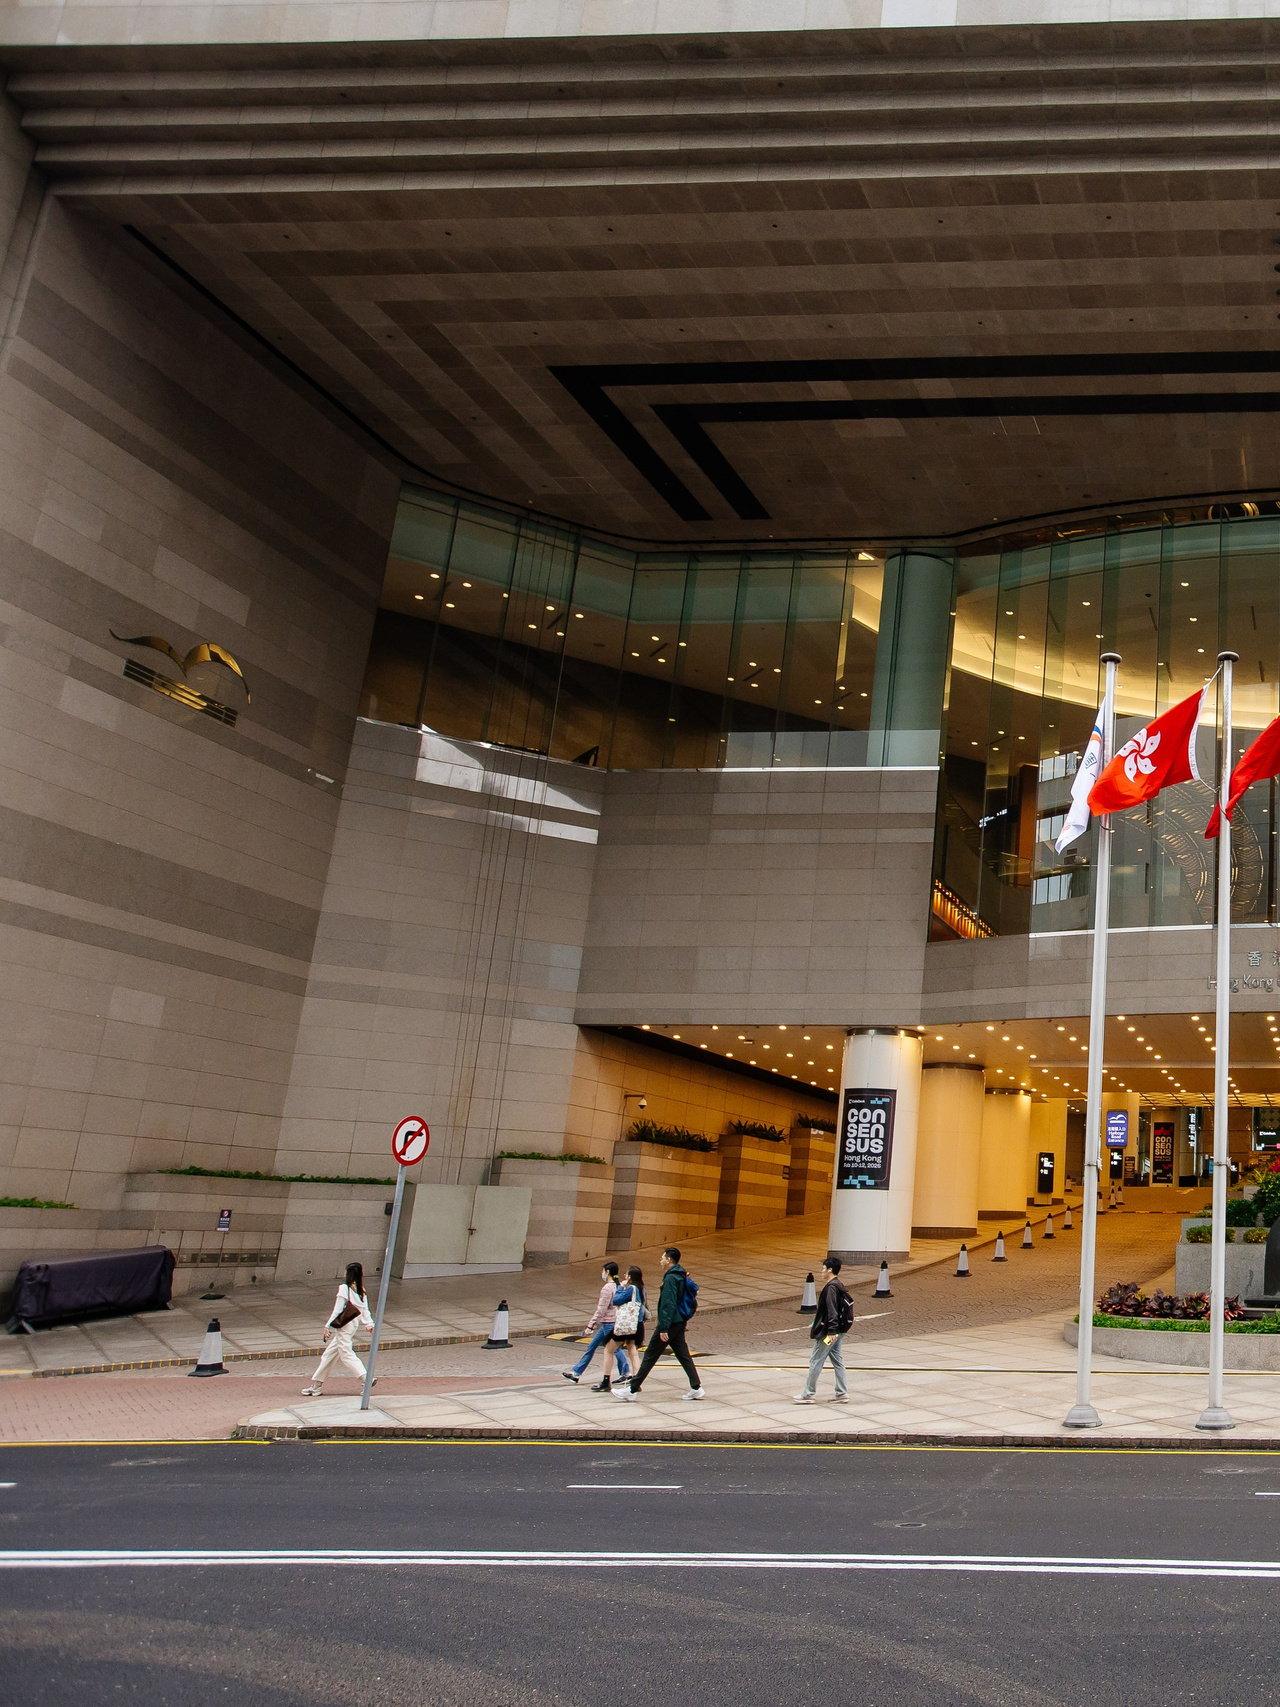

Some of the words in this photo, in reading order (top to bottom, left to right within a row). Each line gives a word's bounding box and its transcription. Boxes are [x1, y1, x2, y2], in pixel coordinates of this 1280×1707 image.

[1206, 975, 1239, 993] Hg
[1243, 974, 1274, 993] Kong
[847, 1108, 886, 1124] CON
[846, 1123, 885, 1139] SEN
[845, 1138, 884, 1153] SUS
[844, 1154, 861, 1163] Hong
[861, 1154, 882, 1164] Kong
